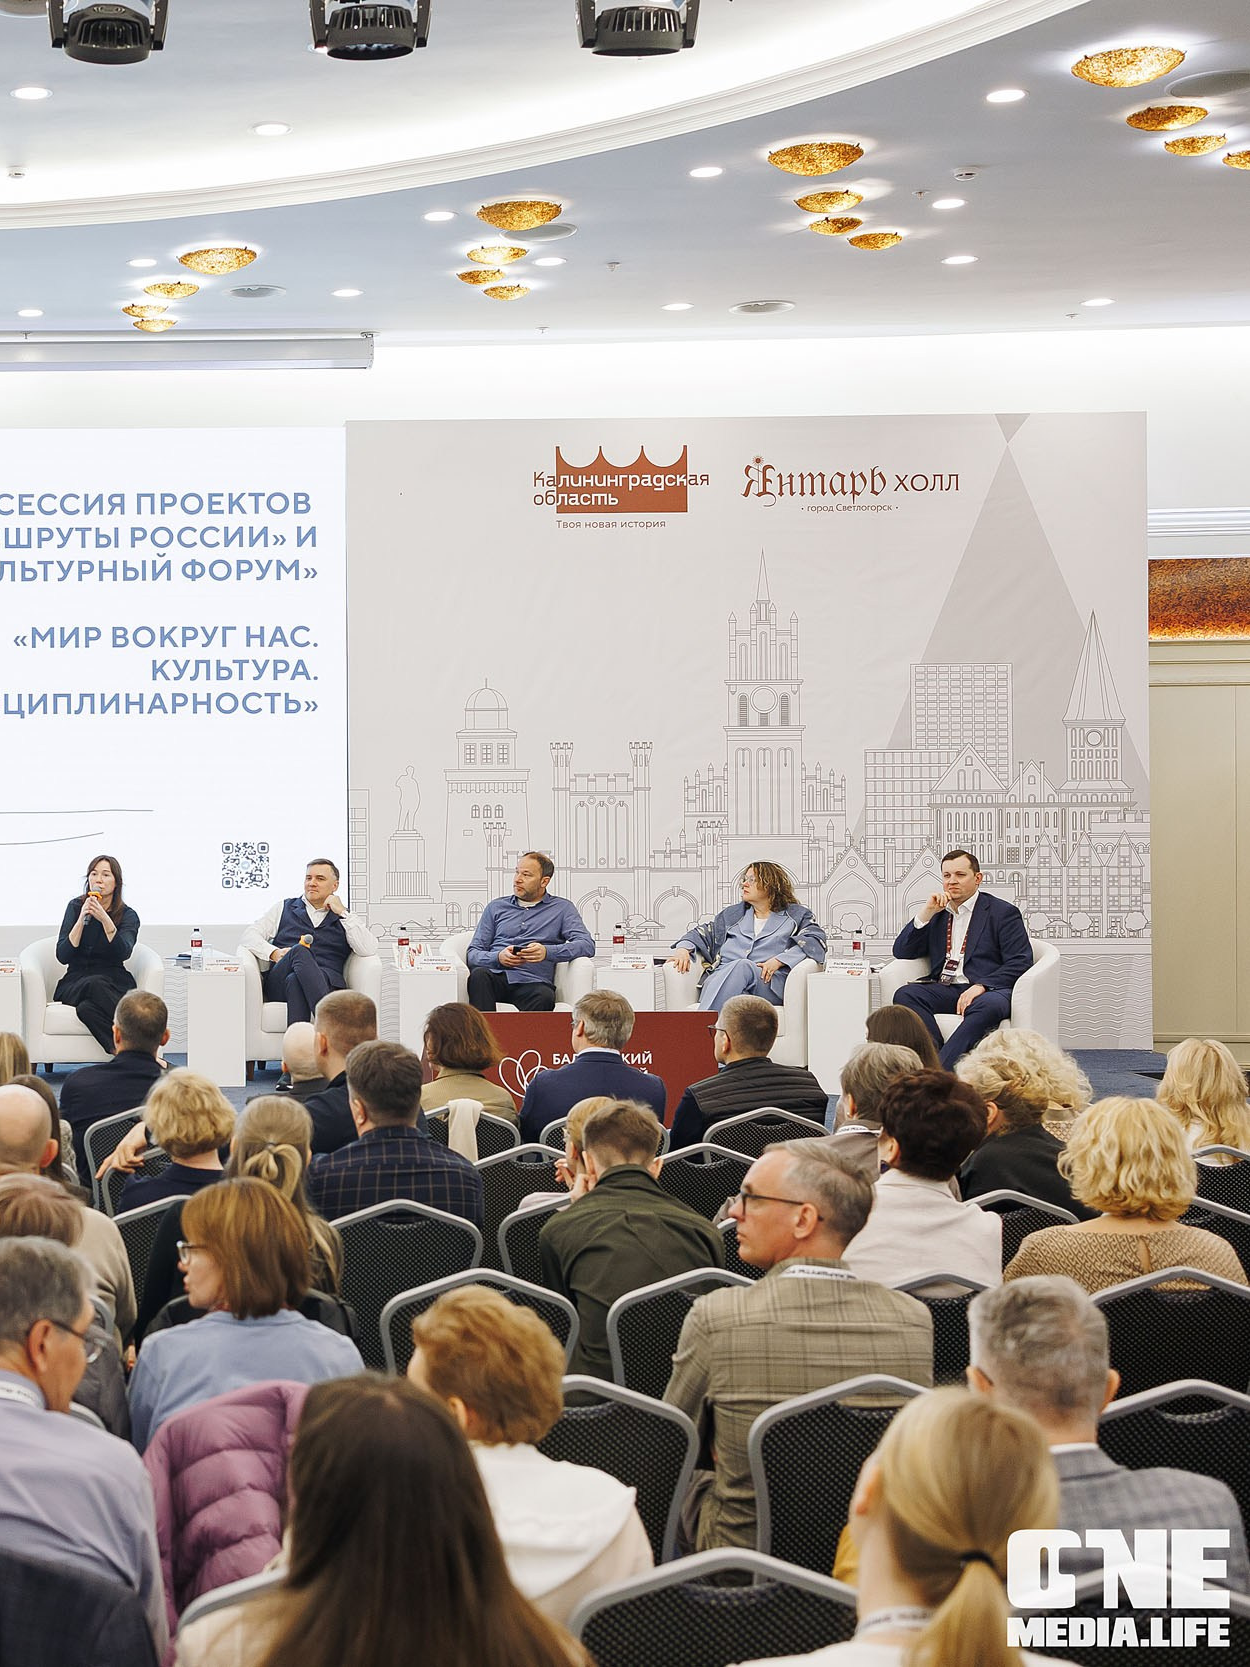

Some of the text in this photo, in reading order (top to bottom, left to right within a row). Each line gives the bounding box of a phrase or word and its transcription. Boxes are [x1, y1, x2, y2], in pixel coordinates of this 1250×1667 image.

[532, 471, 710, 491] Калининградская
[741, 464, 887, 508] Янтарь
[136, 491, 312, 515] ПРОЕКТОВ
[533, 489, 619, 506] область
[807, 503, 893, 514] город Светлогорск
[130, 525, 287, 548] РОССИИ»
[296, 525, 317, 547] И
[556, 520, 666, 530] Твоя новая история
[181, 557, 318, 582] ФОРУМ»
[13, 625, 319, 649] «МИР ВОКРУГ НАС.
[151, 658, 319, 682] КУЛЬТУРА.
